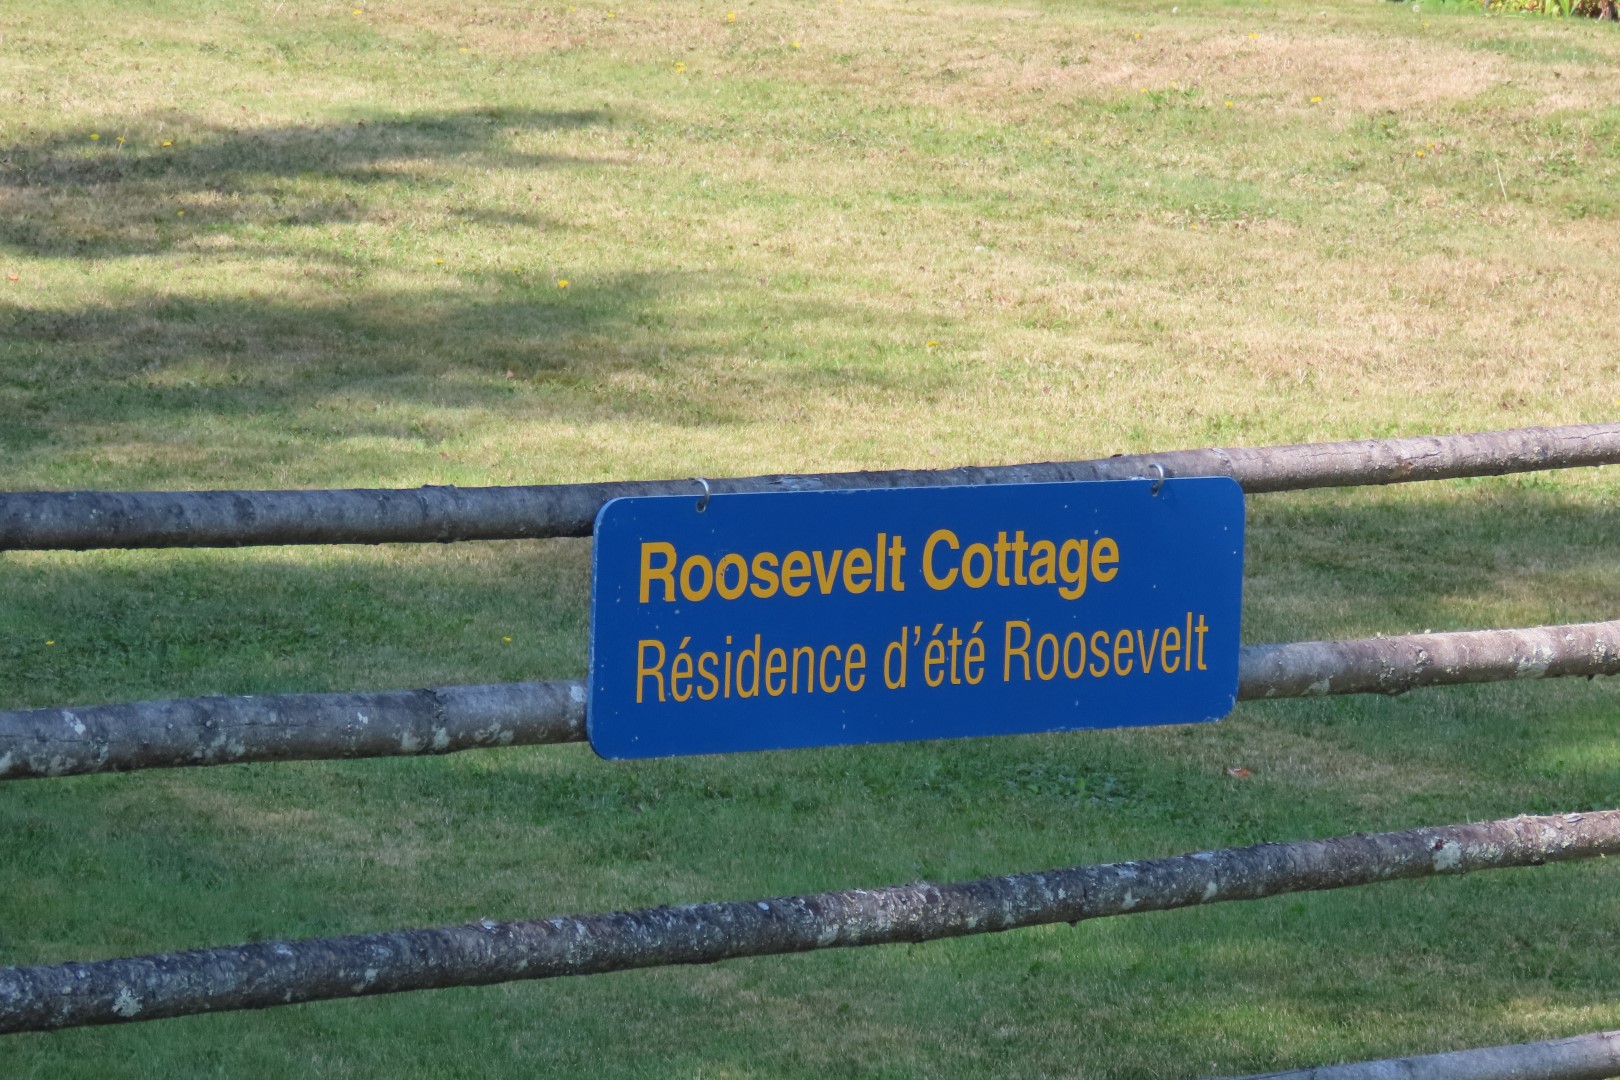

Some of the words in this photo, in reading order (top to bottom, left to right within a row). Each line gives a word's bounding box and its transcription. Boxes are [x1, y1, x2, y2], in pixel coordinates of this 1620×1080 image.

[639, 532, 906, 603] Roosevelt
[922, 529, 1120, 601] Cottage
[636, 632, 867, 704] Résidence
[1003, 611, 1209, 682] Roosevelt
